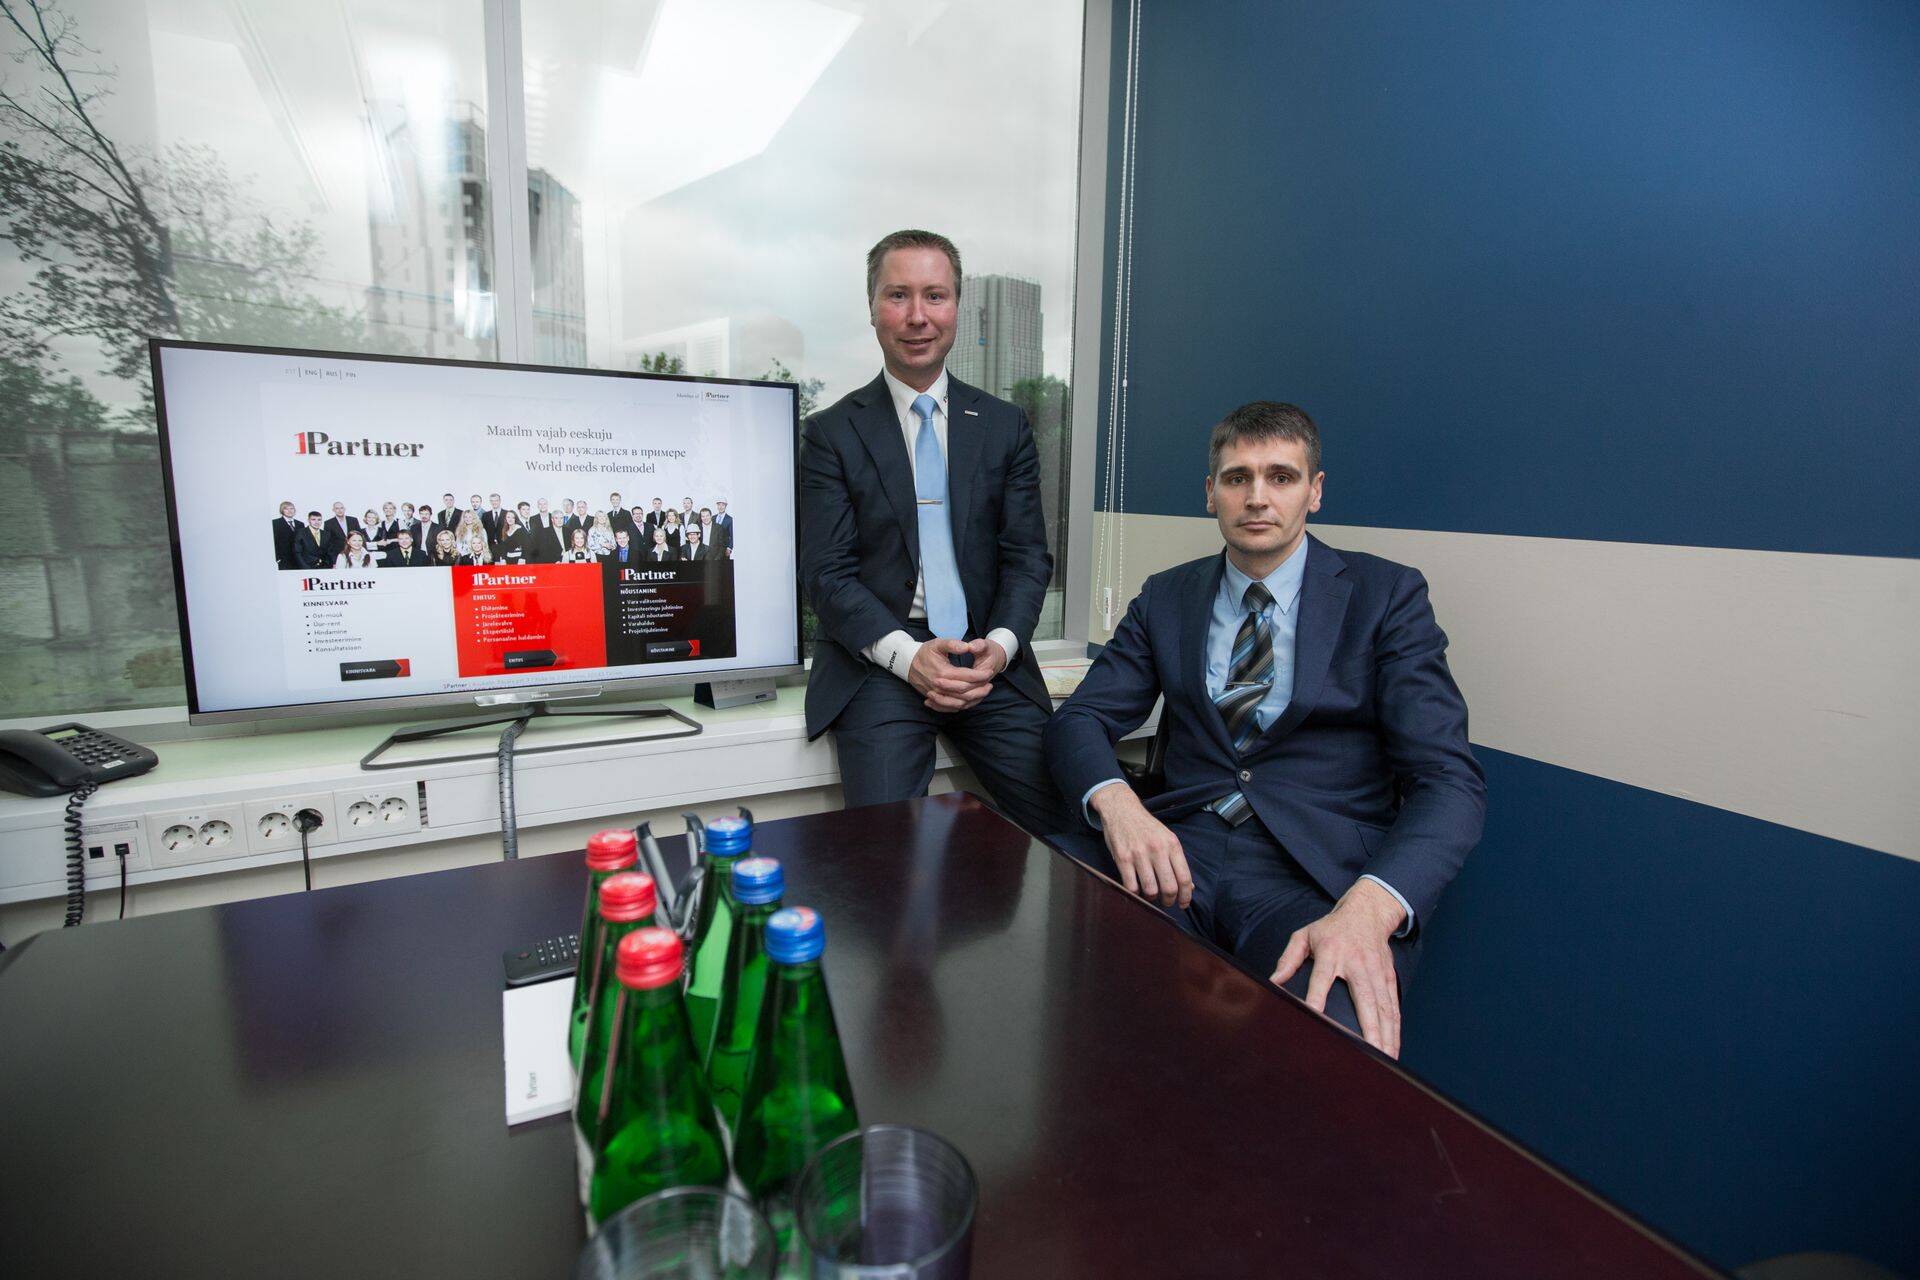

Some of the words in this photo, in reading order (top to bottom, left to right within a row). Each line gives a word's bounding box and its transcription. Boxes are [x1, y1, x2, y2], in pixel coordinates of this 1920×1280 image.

[486, 425, 533, 438] Maailm
[535, 427, 568, 440] vajab
[569, 429, 613, 441] eeskuju
[295, 431, 424, 458] 1Partner
[538, 444, 565, 457] Мир
[568, 447, 628, 458] нуждается
[640, 449, 686, 459] примере
[526, 460, 563, 472] World
[565, 461, 598, 473] needs
[600, 462, 656, 474] rolemodel
[472, 572, 537, 587] 1Partner
[620, 568, 677, 581] 1Partner
[303, 577, 376, 592] 1Partner
[303, 600, 349, 608] KINNISVARA
